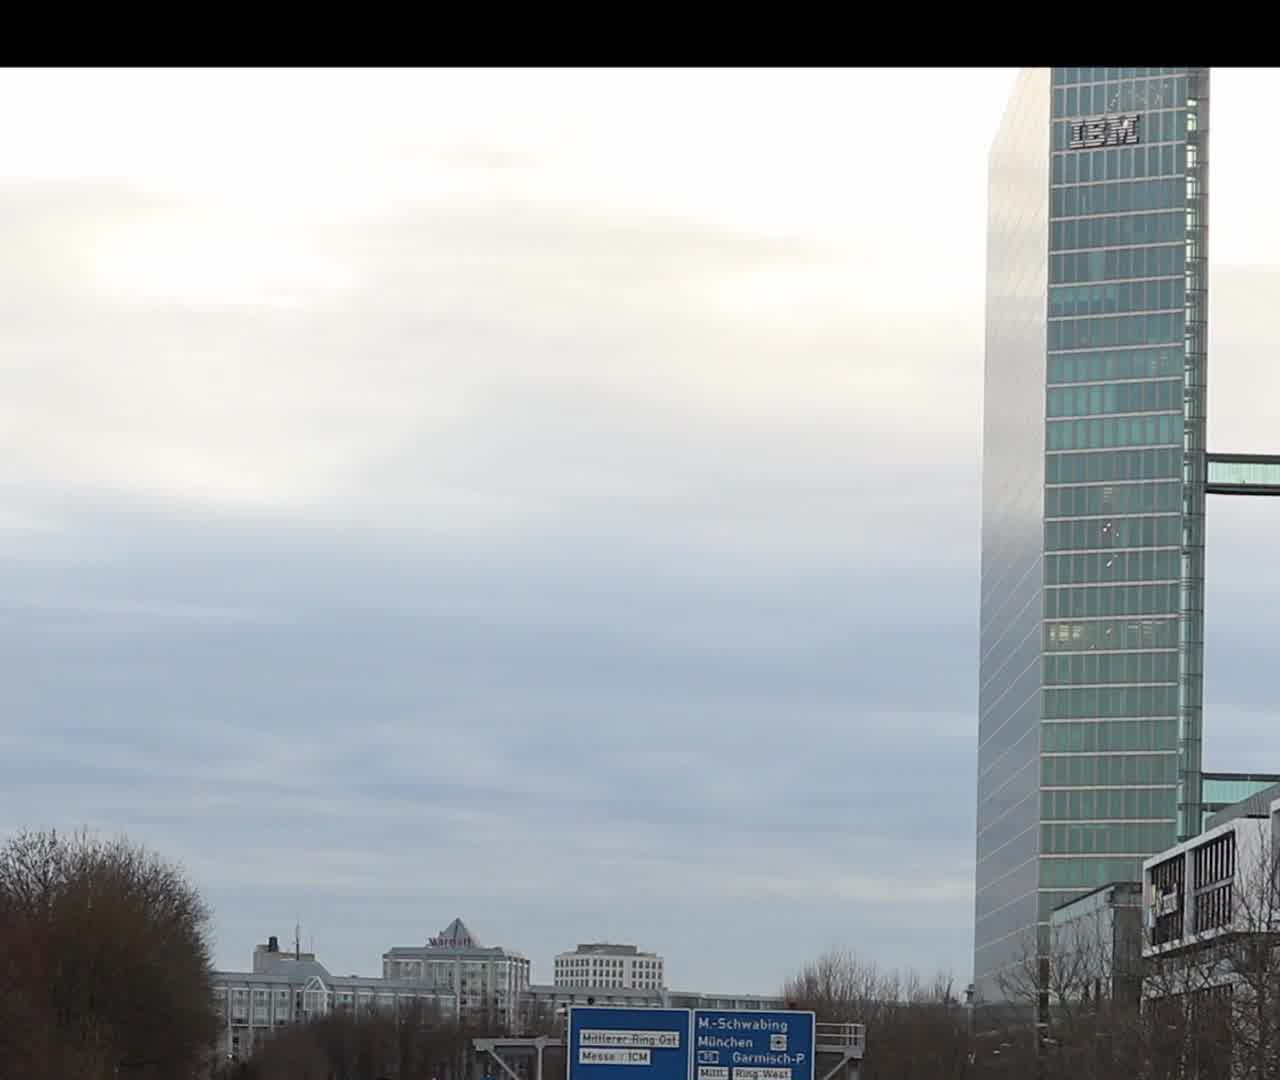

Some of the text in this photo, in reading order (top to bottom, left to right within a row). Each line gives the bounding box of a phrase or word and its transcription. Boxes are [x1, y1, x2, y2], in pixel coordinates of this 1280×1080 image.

[1072, 115, 1137, 149] IBM
[698, 1017, 788, 1033] M.-Schwabing
[698, 1035, 753, 1048] München
[736, 1068, 758, 1080] Ring
[760, 1069, 788, 1080] West
